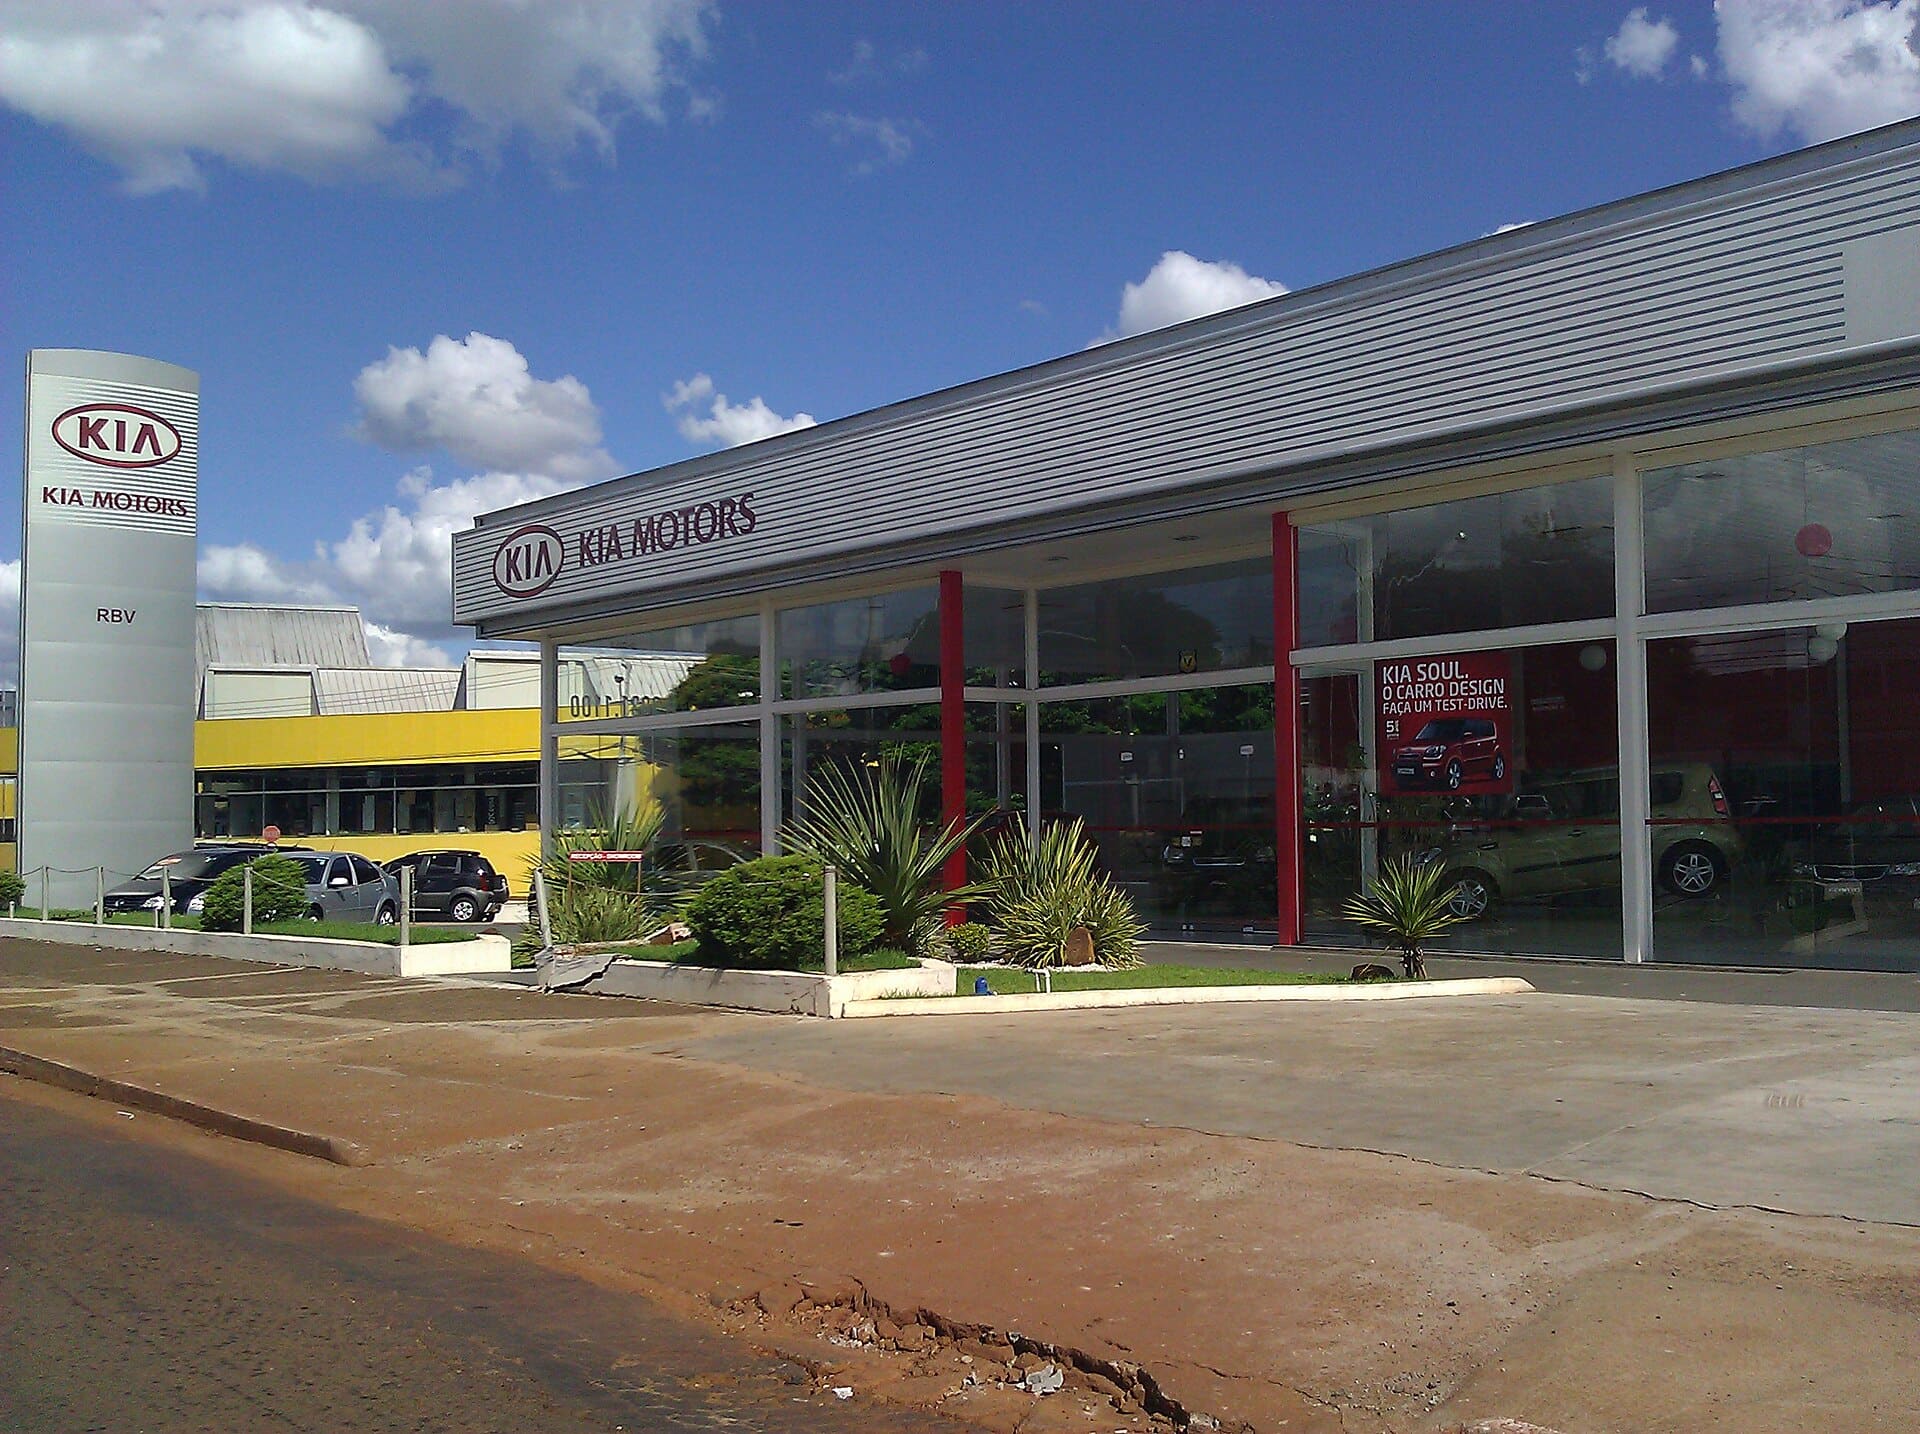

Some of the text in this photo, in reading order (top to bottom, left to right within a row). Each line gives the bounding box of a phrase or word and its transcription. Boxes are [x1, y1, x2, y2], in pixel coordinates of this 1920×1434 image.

[77, 415, 163, 457] KIA
[42, 486, 188, 517] KIA MOTORS
[579, 492, 757, 568] KIA MOTORS
[505, 540, 553, 585] KIA
[97, 608, 136, 624] RBV
[1382, 661, 1469, 685] KIA SOUL.
[1382, 678, 1505, 701] O CARRO DESIGN
[1382, 695, 1508, 716] FAÇA UM TEST-DRIVE.
